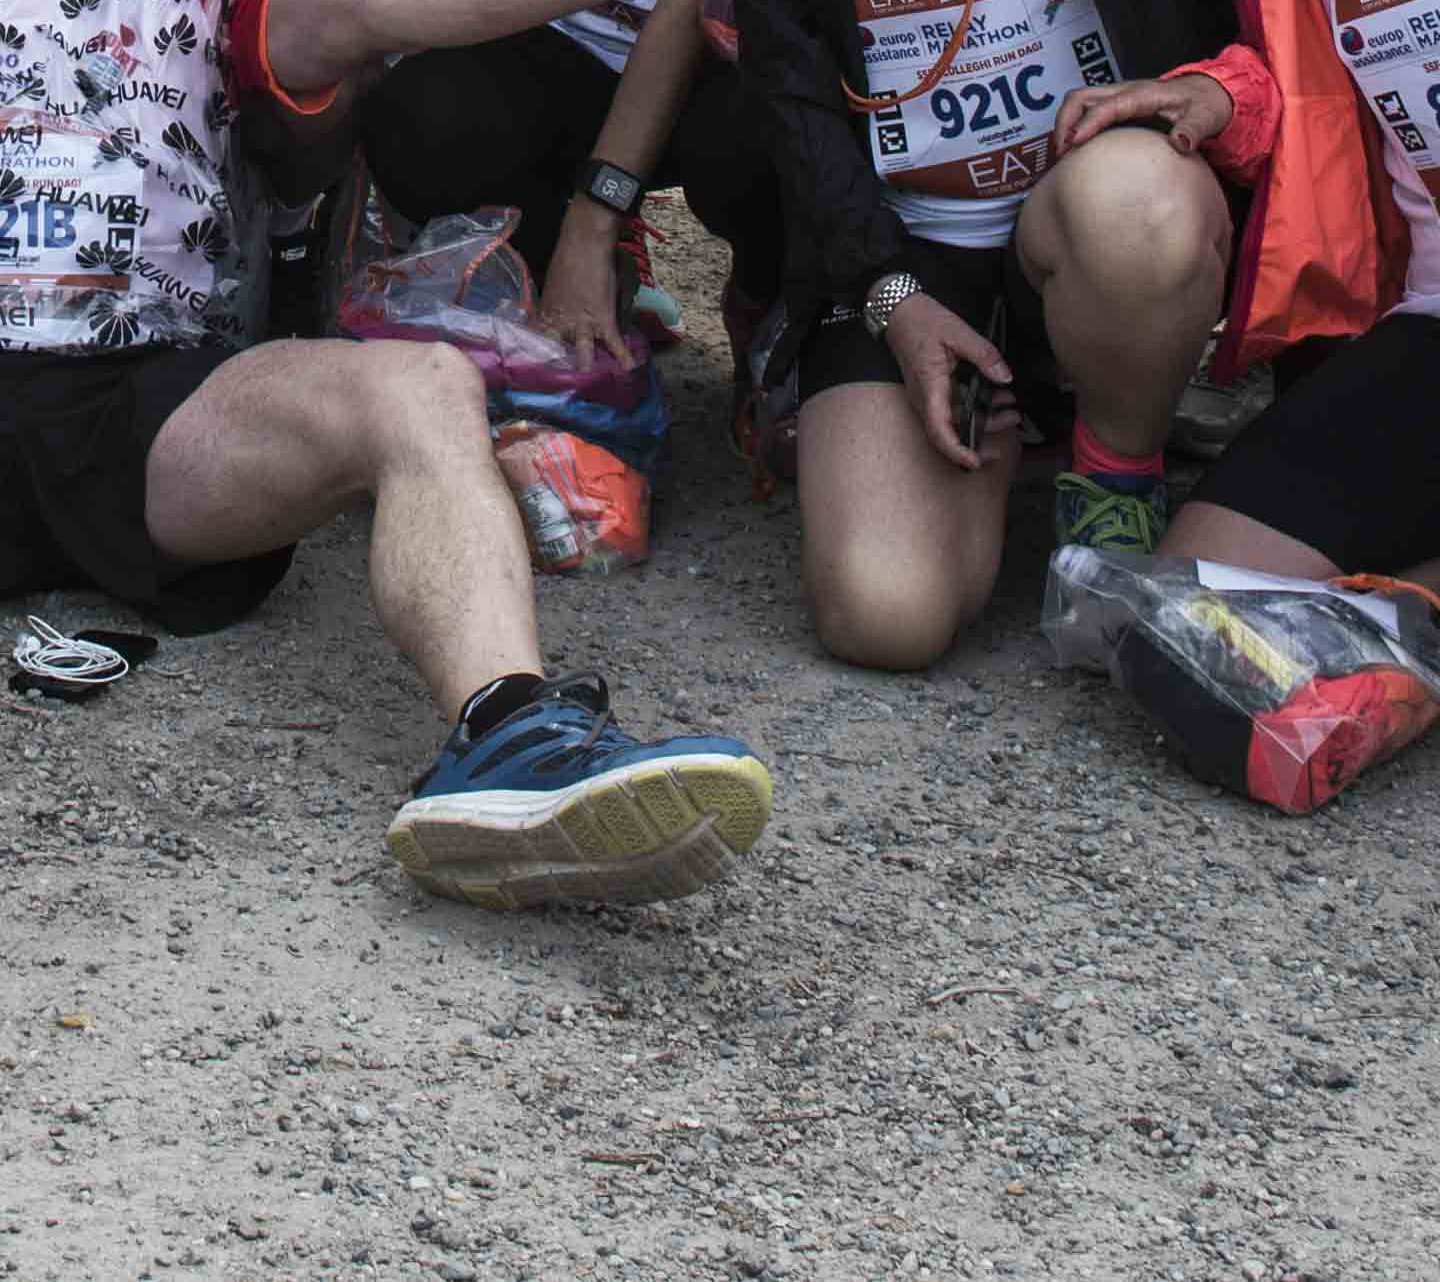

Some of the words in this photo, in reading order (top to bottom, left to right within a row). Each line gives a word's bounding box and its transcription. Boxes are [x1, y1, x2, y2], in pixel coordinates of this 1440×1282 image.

[879, 33, 916, 48] europ
[1367, 28, 1405, 48] europ
[993, 52, 1017, 68] RUN
[1352, 44, 1413, 69] assistance
[1423, 60, 1440, 74] SSF
[108, 81, 187, 109] HUAWEI
[931, 64, 1055, 139] 921C
[968, 137, 1049, 188] EA7
